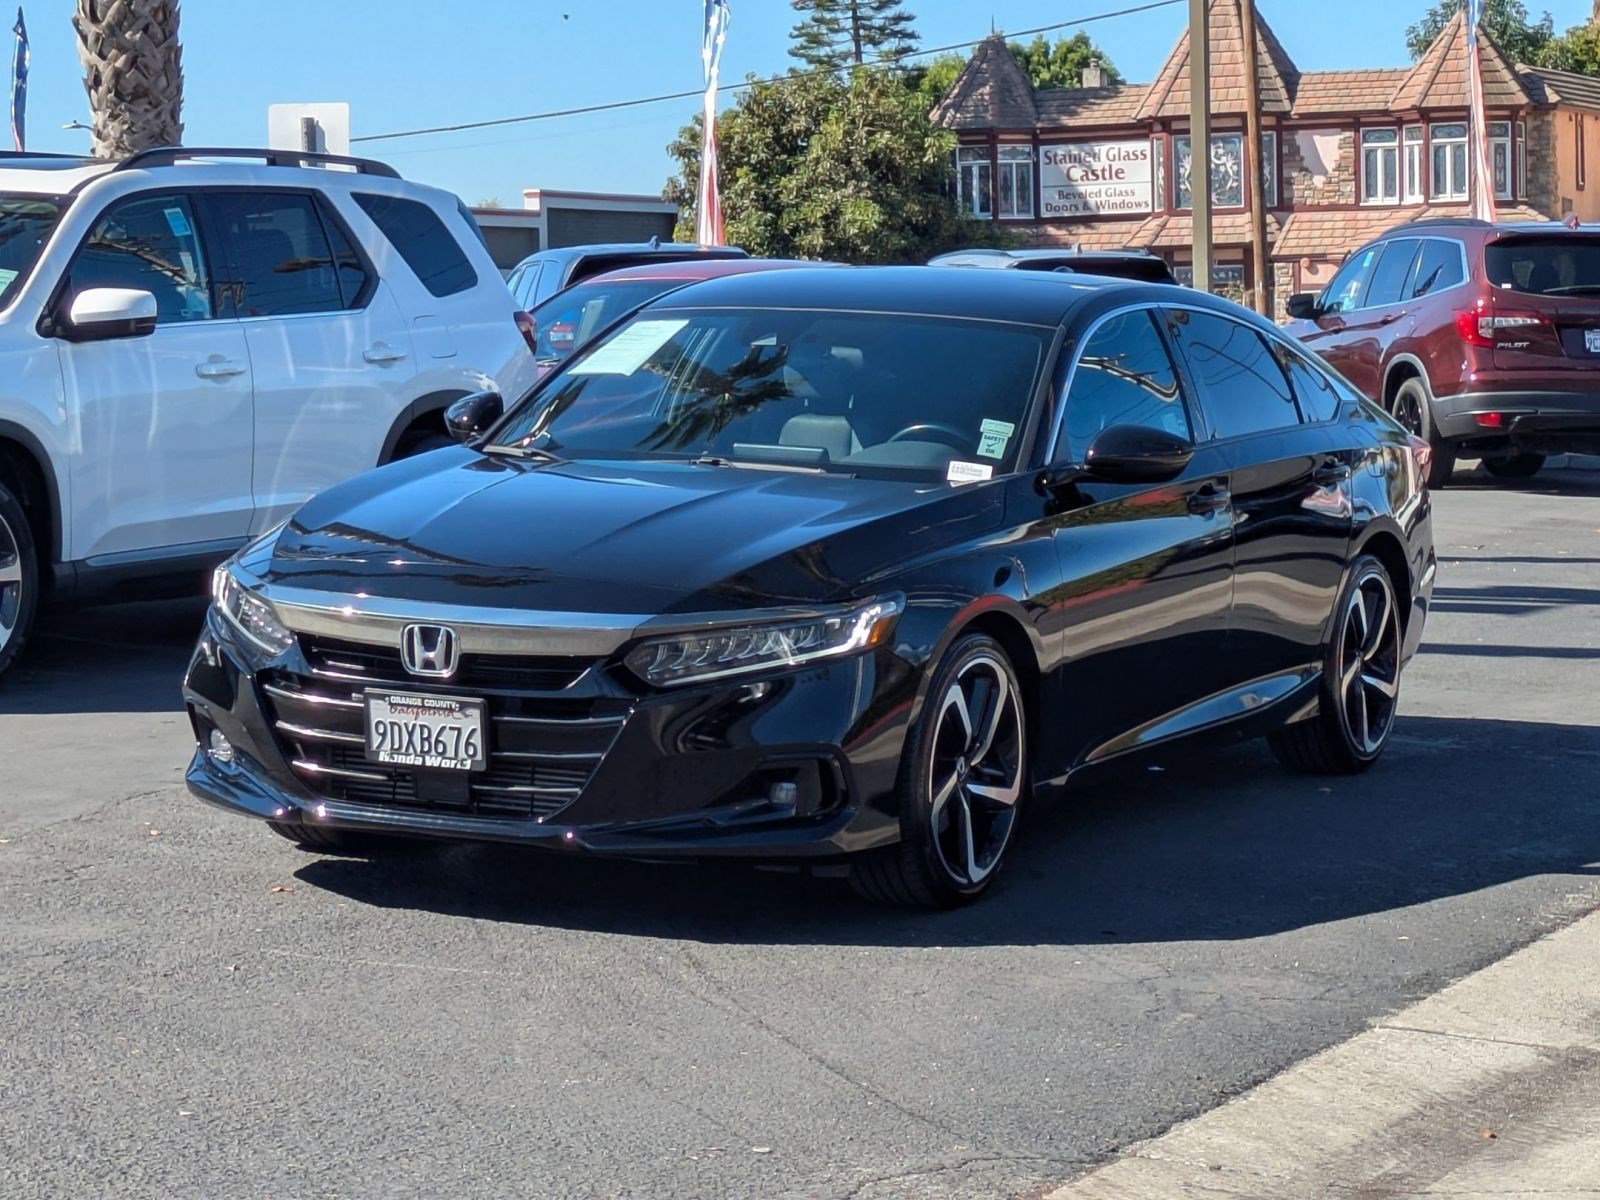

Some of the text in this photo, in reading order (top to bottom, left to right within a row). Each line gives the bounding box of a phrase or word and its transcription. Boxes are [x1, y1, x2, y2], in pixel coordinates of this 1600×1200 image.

[1043, 146, 1148, 166] Stained Glass
[1065, 163, 1126, 182] Castle
[1057, 187, 1136, 201] Beveled Glass
[1045, 199, 1150, 213] Doors & Windows
[1496, 341, 1531, 349] PILOT
[983, 434, 1006, 443] SAFETY
[390, 695, 457, 709] ORANGE COUNTY
[374, 719, 478, 759] 9DXB676
